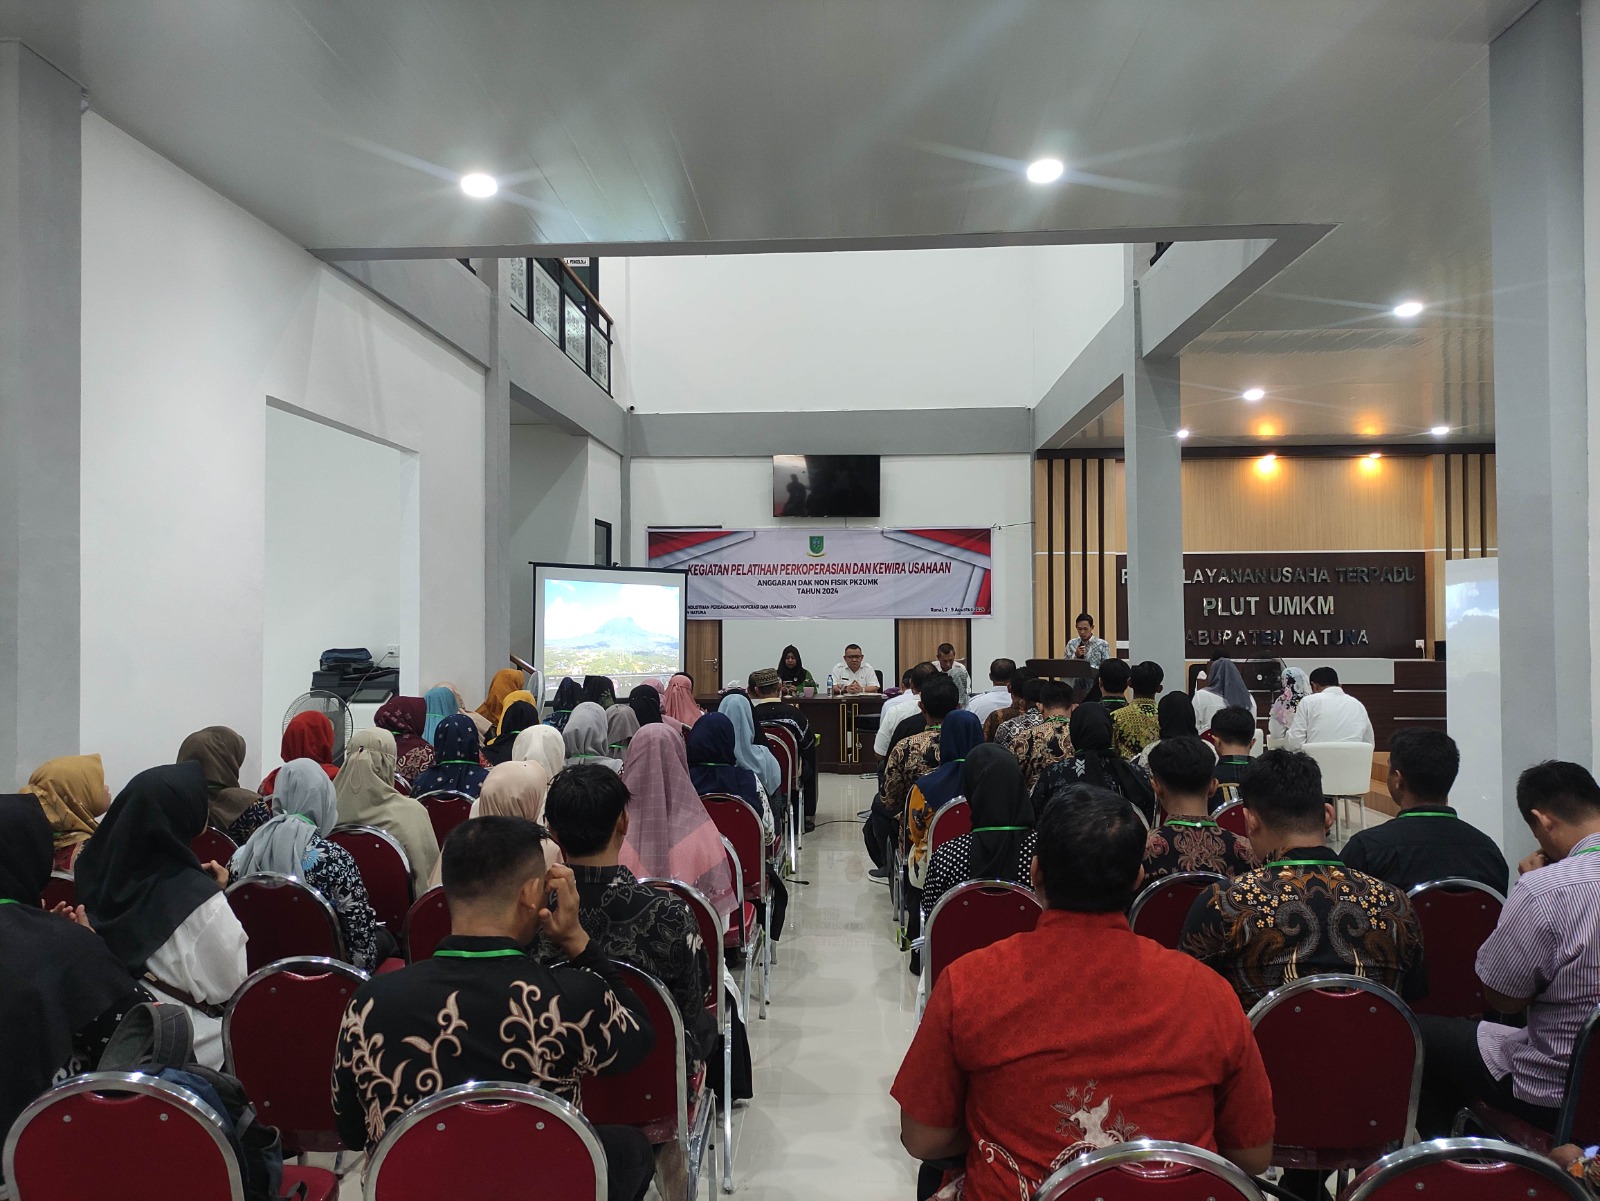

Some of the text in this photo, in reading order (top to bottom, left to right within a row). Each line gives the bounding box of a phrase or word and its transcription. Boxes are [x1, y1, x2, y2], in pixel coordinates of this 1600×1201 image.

[687, 561, 952, 576] KEGIATAN PELATIHAN PERKOPERASIAN DAN KEWIRA USAHAAN
[1270, 566, 1331, 583] USAHA
[1335, 565, 1416, 583] TERPADU
[849, 578, 879, 586] PK2UMK
[797, 587, 839, 595] TAHUN 2024
[1203, 595, 1335, 617] PLUT UMKM
[1185, 629, 1369, 646] ABUPATEN NATUNA
